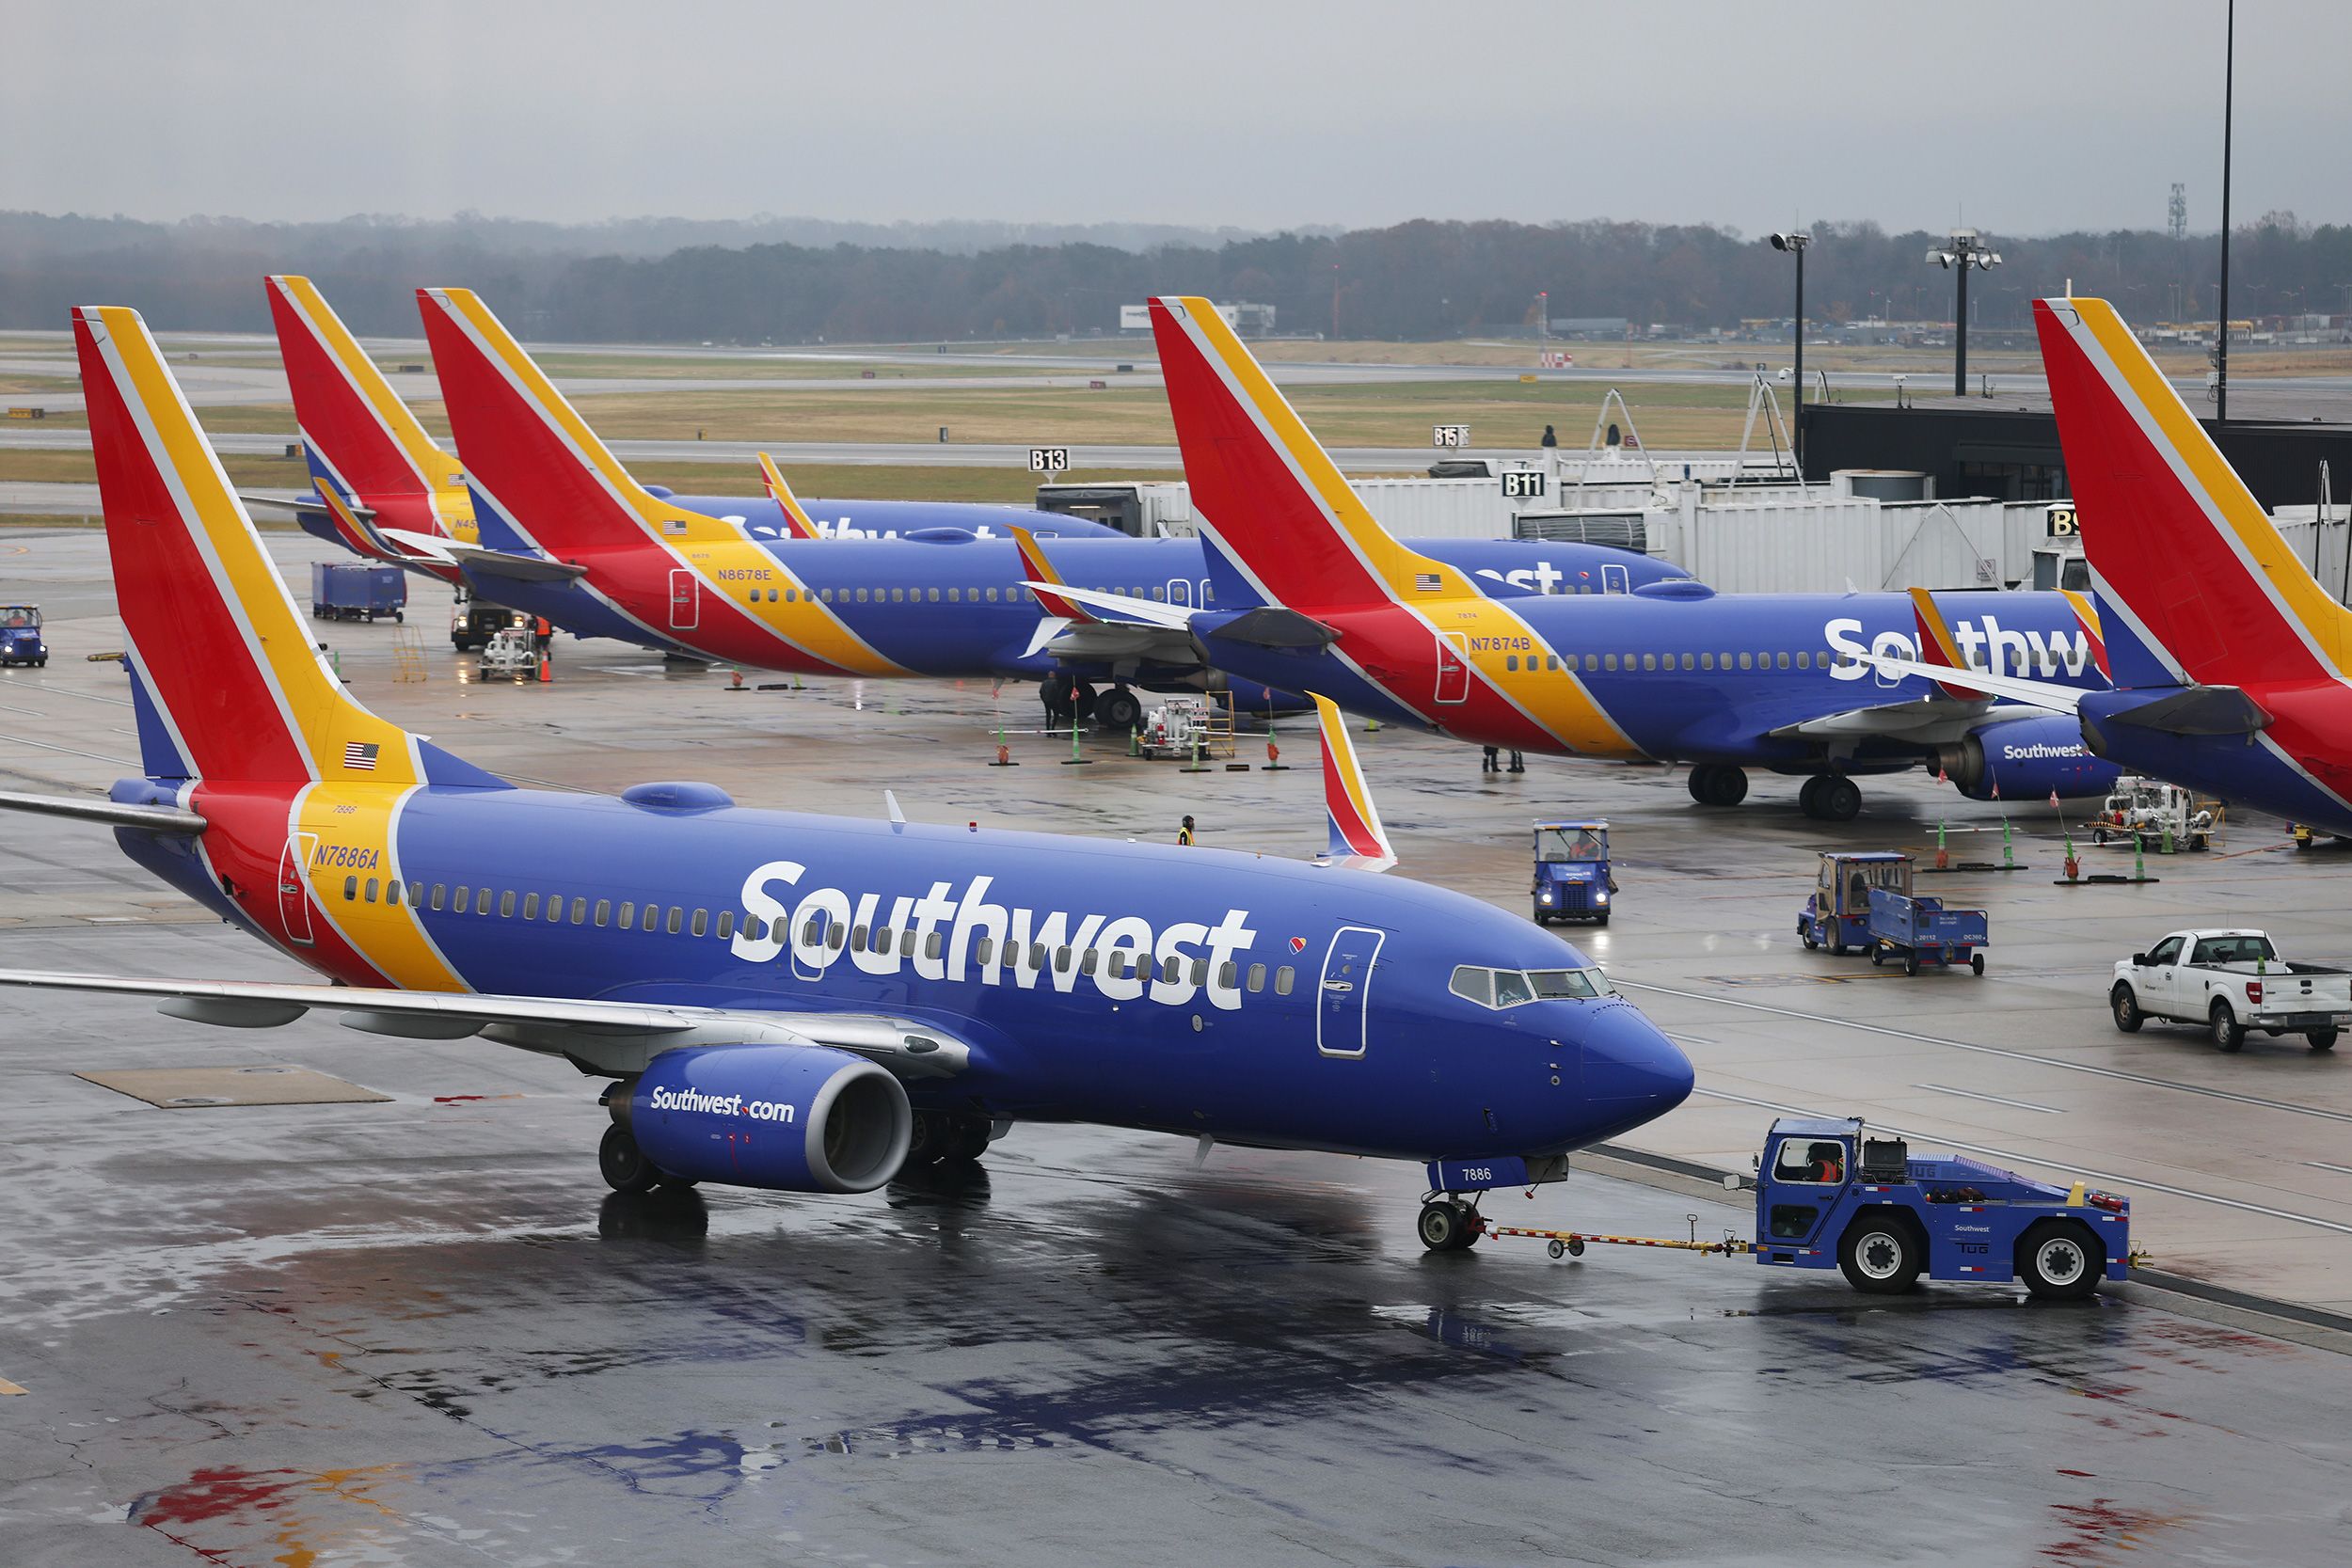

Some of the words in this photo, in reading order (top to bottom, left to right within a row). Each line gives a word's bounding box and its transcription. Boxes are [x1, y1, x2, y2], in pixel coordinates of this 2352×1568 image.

[1434, 428, 1457, 446] B15
[1031, 450, 1066, 470] B13
[1505, 474, 1542, 496] B11
[718, 569, 771, 580] N8678E
[1470, 637, 1531, 651] N7874B
[1824, 615, 2090, 681] Sothw
[332, 805, 358, 814] 7886
[314, 845, 380, 869] N7886A
[731, 861, 1258, 1010] Southwest
[1462, 1167, 1492, 1181] 7886
[1954, 1225, 1990, 1233] Southwest
[1955, 1243, 1989, 1254] TUG
